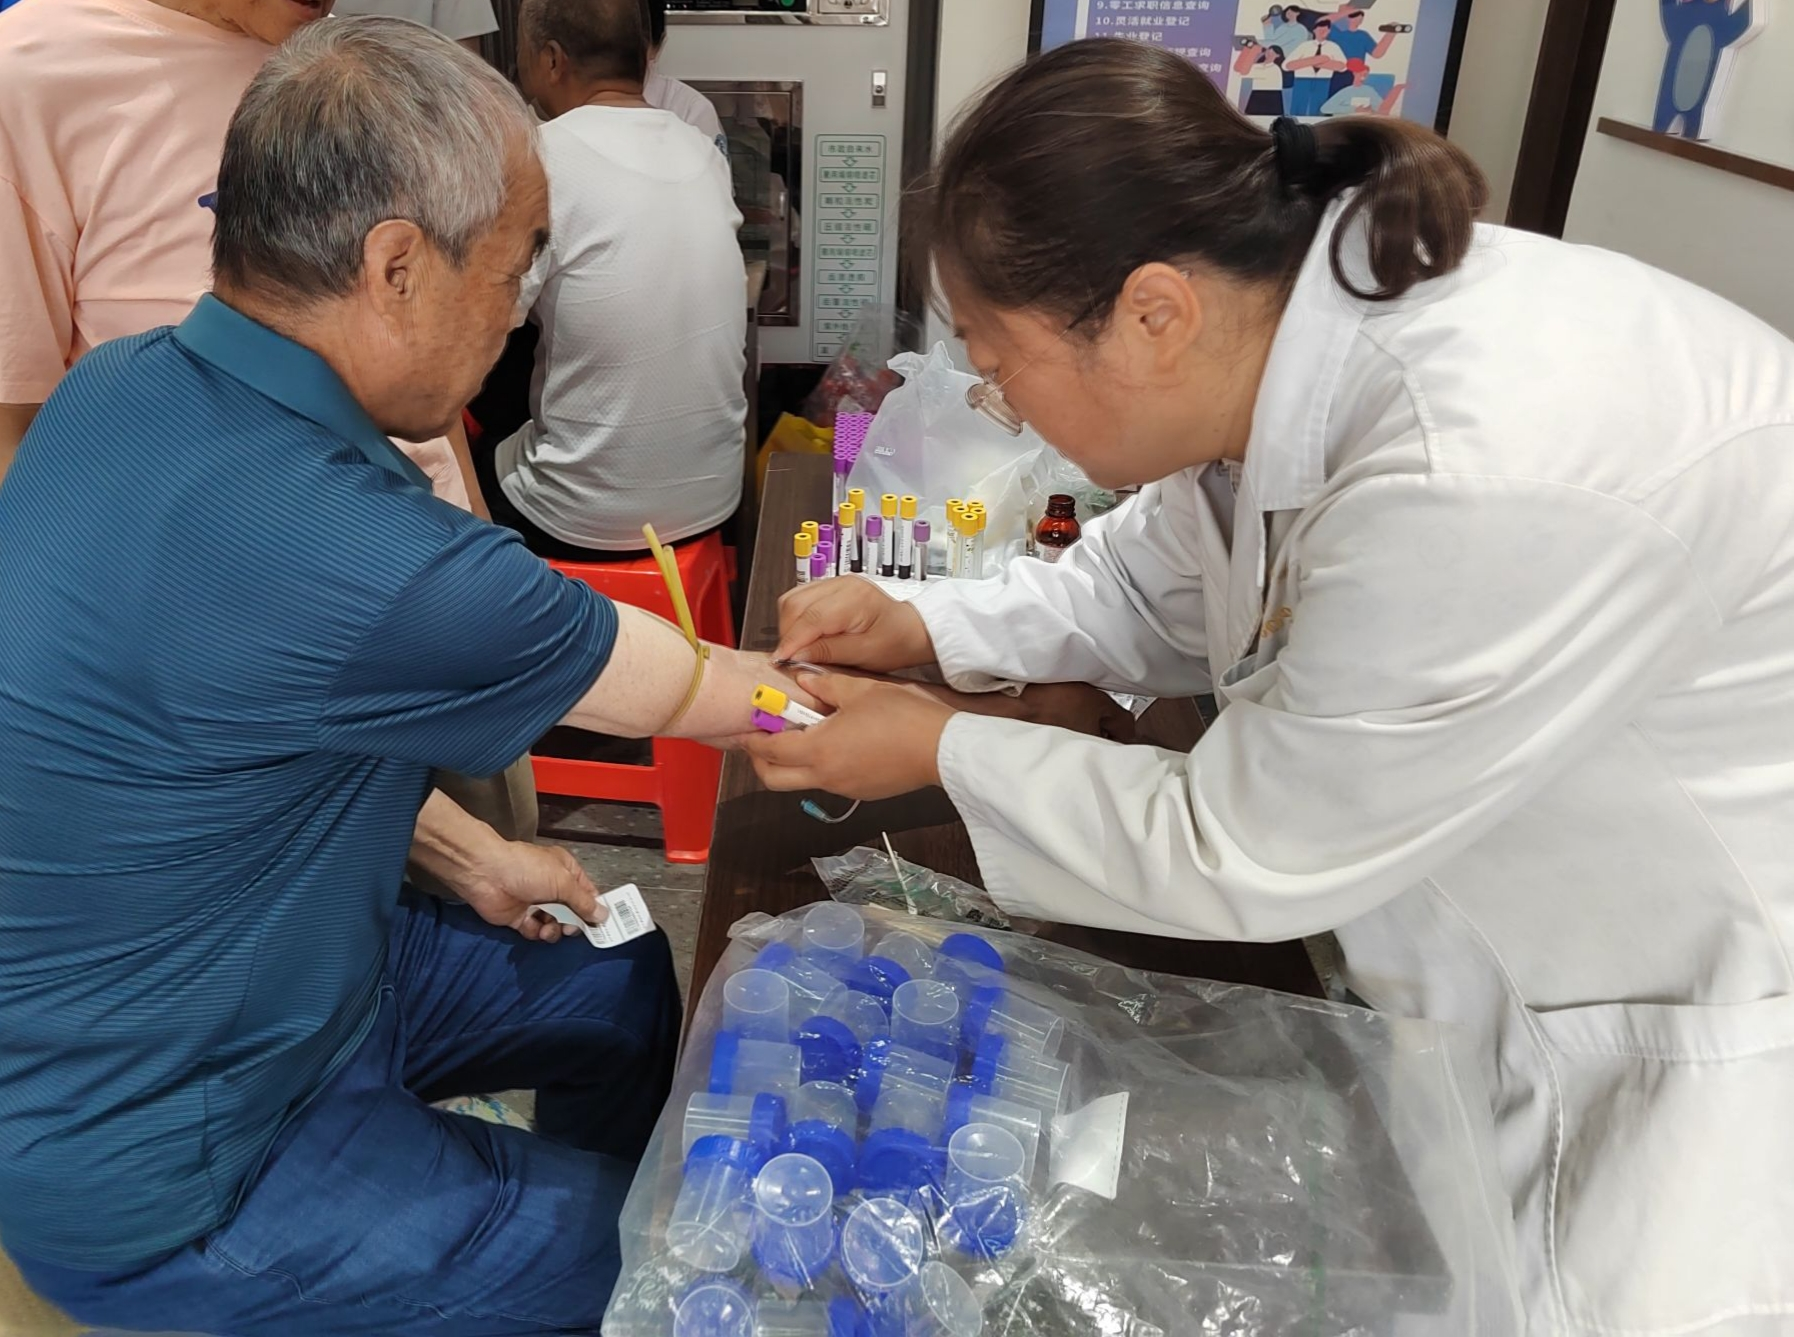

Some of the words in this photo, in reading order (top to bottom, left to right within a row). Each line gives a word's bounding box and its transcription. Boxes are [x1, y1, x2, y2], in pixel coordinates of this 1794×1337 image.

[1095, 16, 1190, 26] 10.灵活就业登记
[1095, 31, 1163, 41] 失业登记
